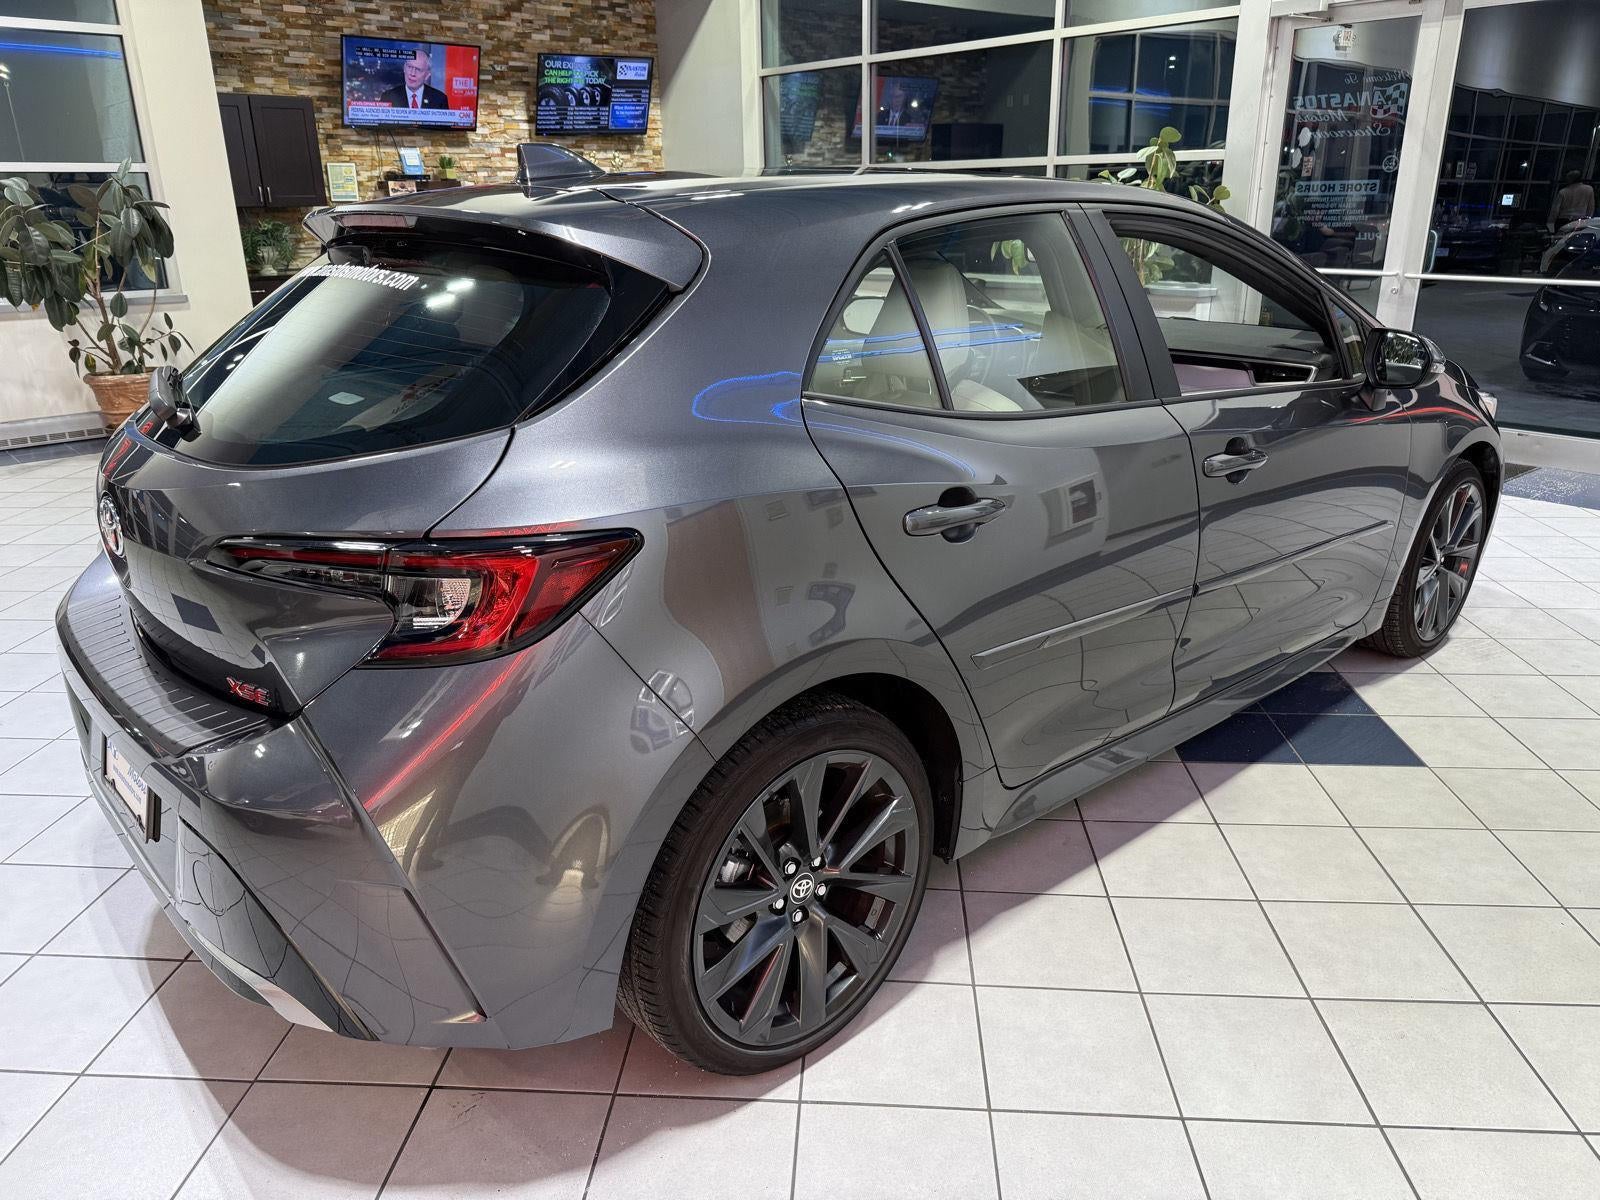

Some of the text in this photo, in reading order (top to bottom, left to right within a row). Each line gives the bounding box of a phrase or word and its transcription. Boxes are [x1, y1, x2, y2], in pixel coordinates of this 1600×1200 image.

[545, 60, 562, 69] OUR
[584, 70, 599, 78] PICK
[556, 77, 573, 85] RIGHT
[585, 77, 605, 85] TODAY
[226, 676, 272, 707] XSE
